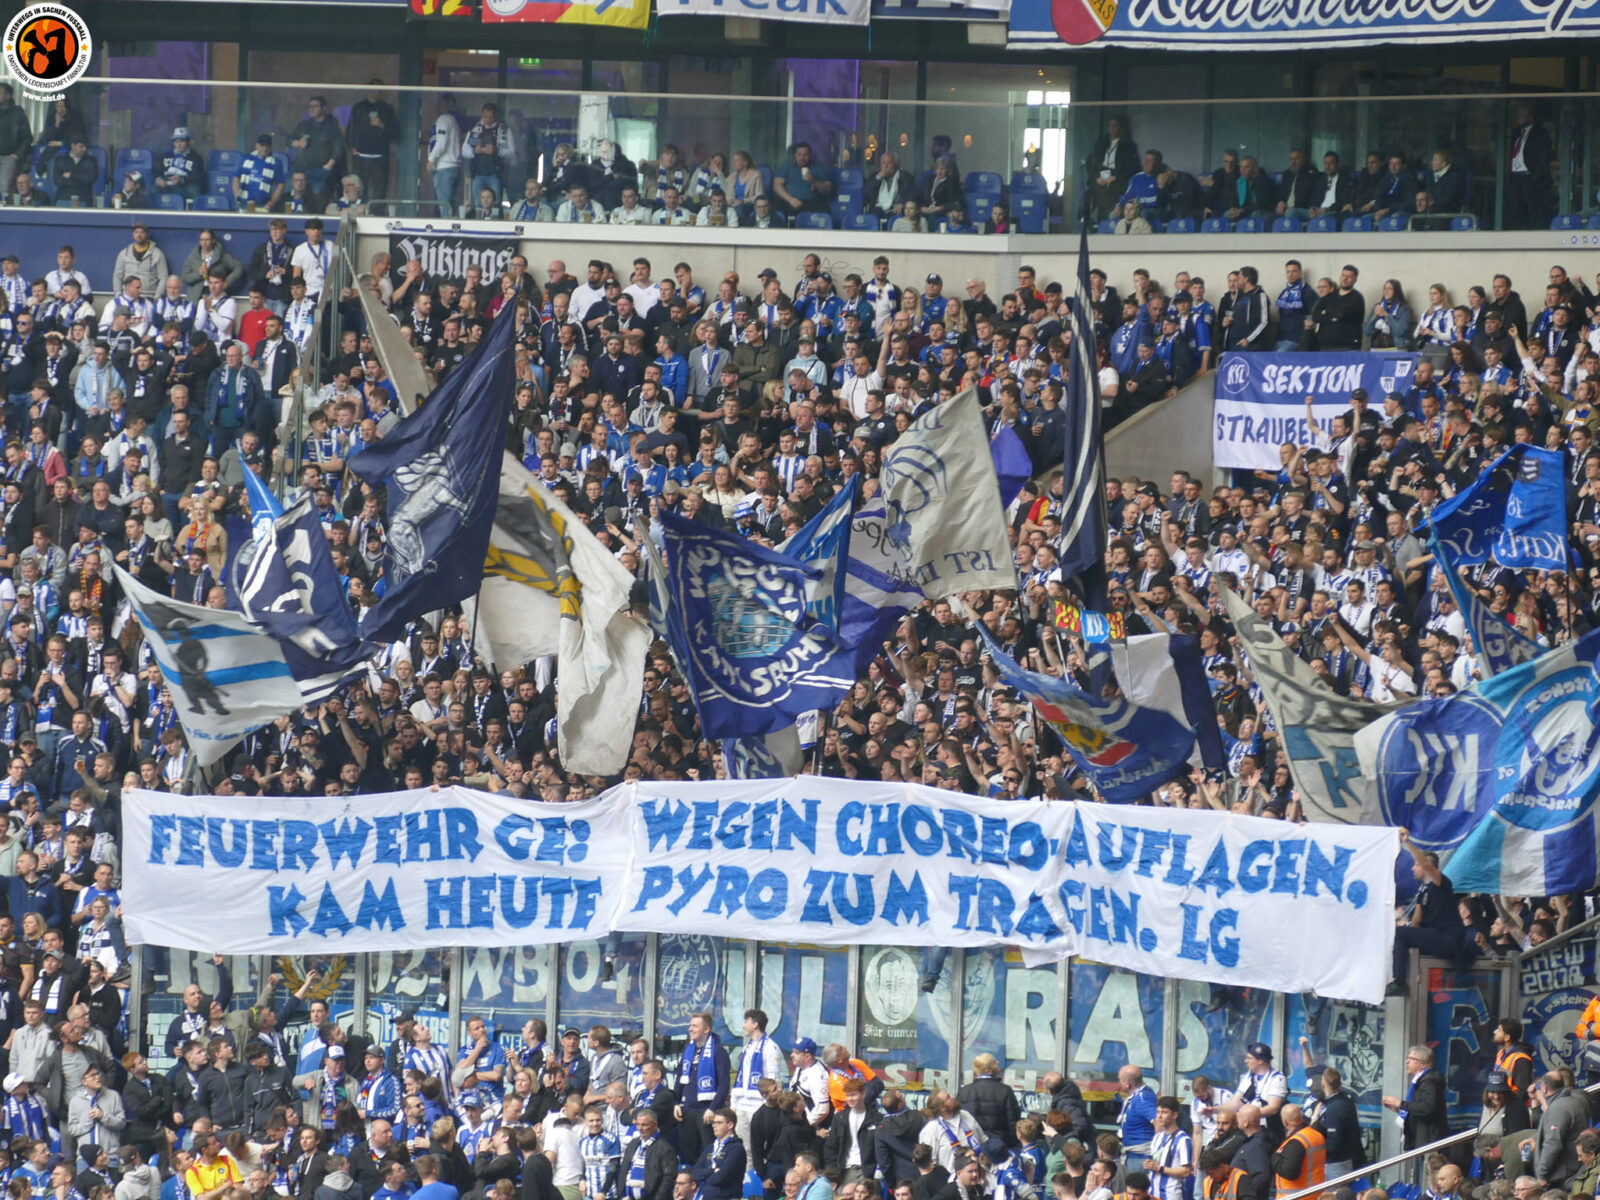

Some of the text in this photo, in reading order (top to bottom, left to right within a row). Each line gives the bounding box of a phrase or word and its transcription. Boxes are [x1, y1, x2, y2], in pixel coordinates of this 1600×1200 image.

[396, 236, 515, 287] Vikings
[1262, 363, 1365, 395] SEKTION
[147, 807, 483, 874] FEUERWEHR
[493, 813, 591, 866] GE:
[638, 798, 822, 855] WEGEN
[267, 862, 1241, 968] KAM HEUTE PYRO ZUM TRAGEN. LG
